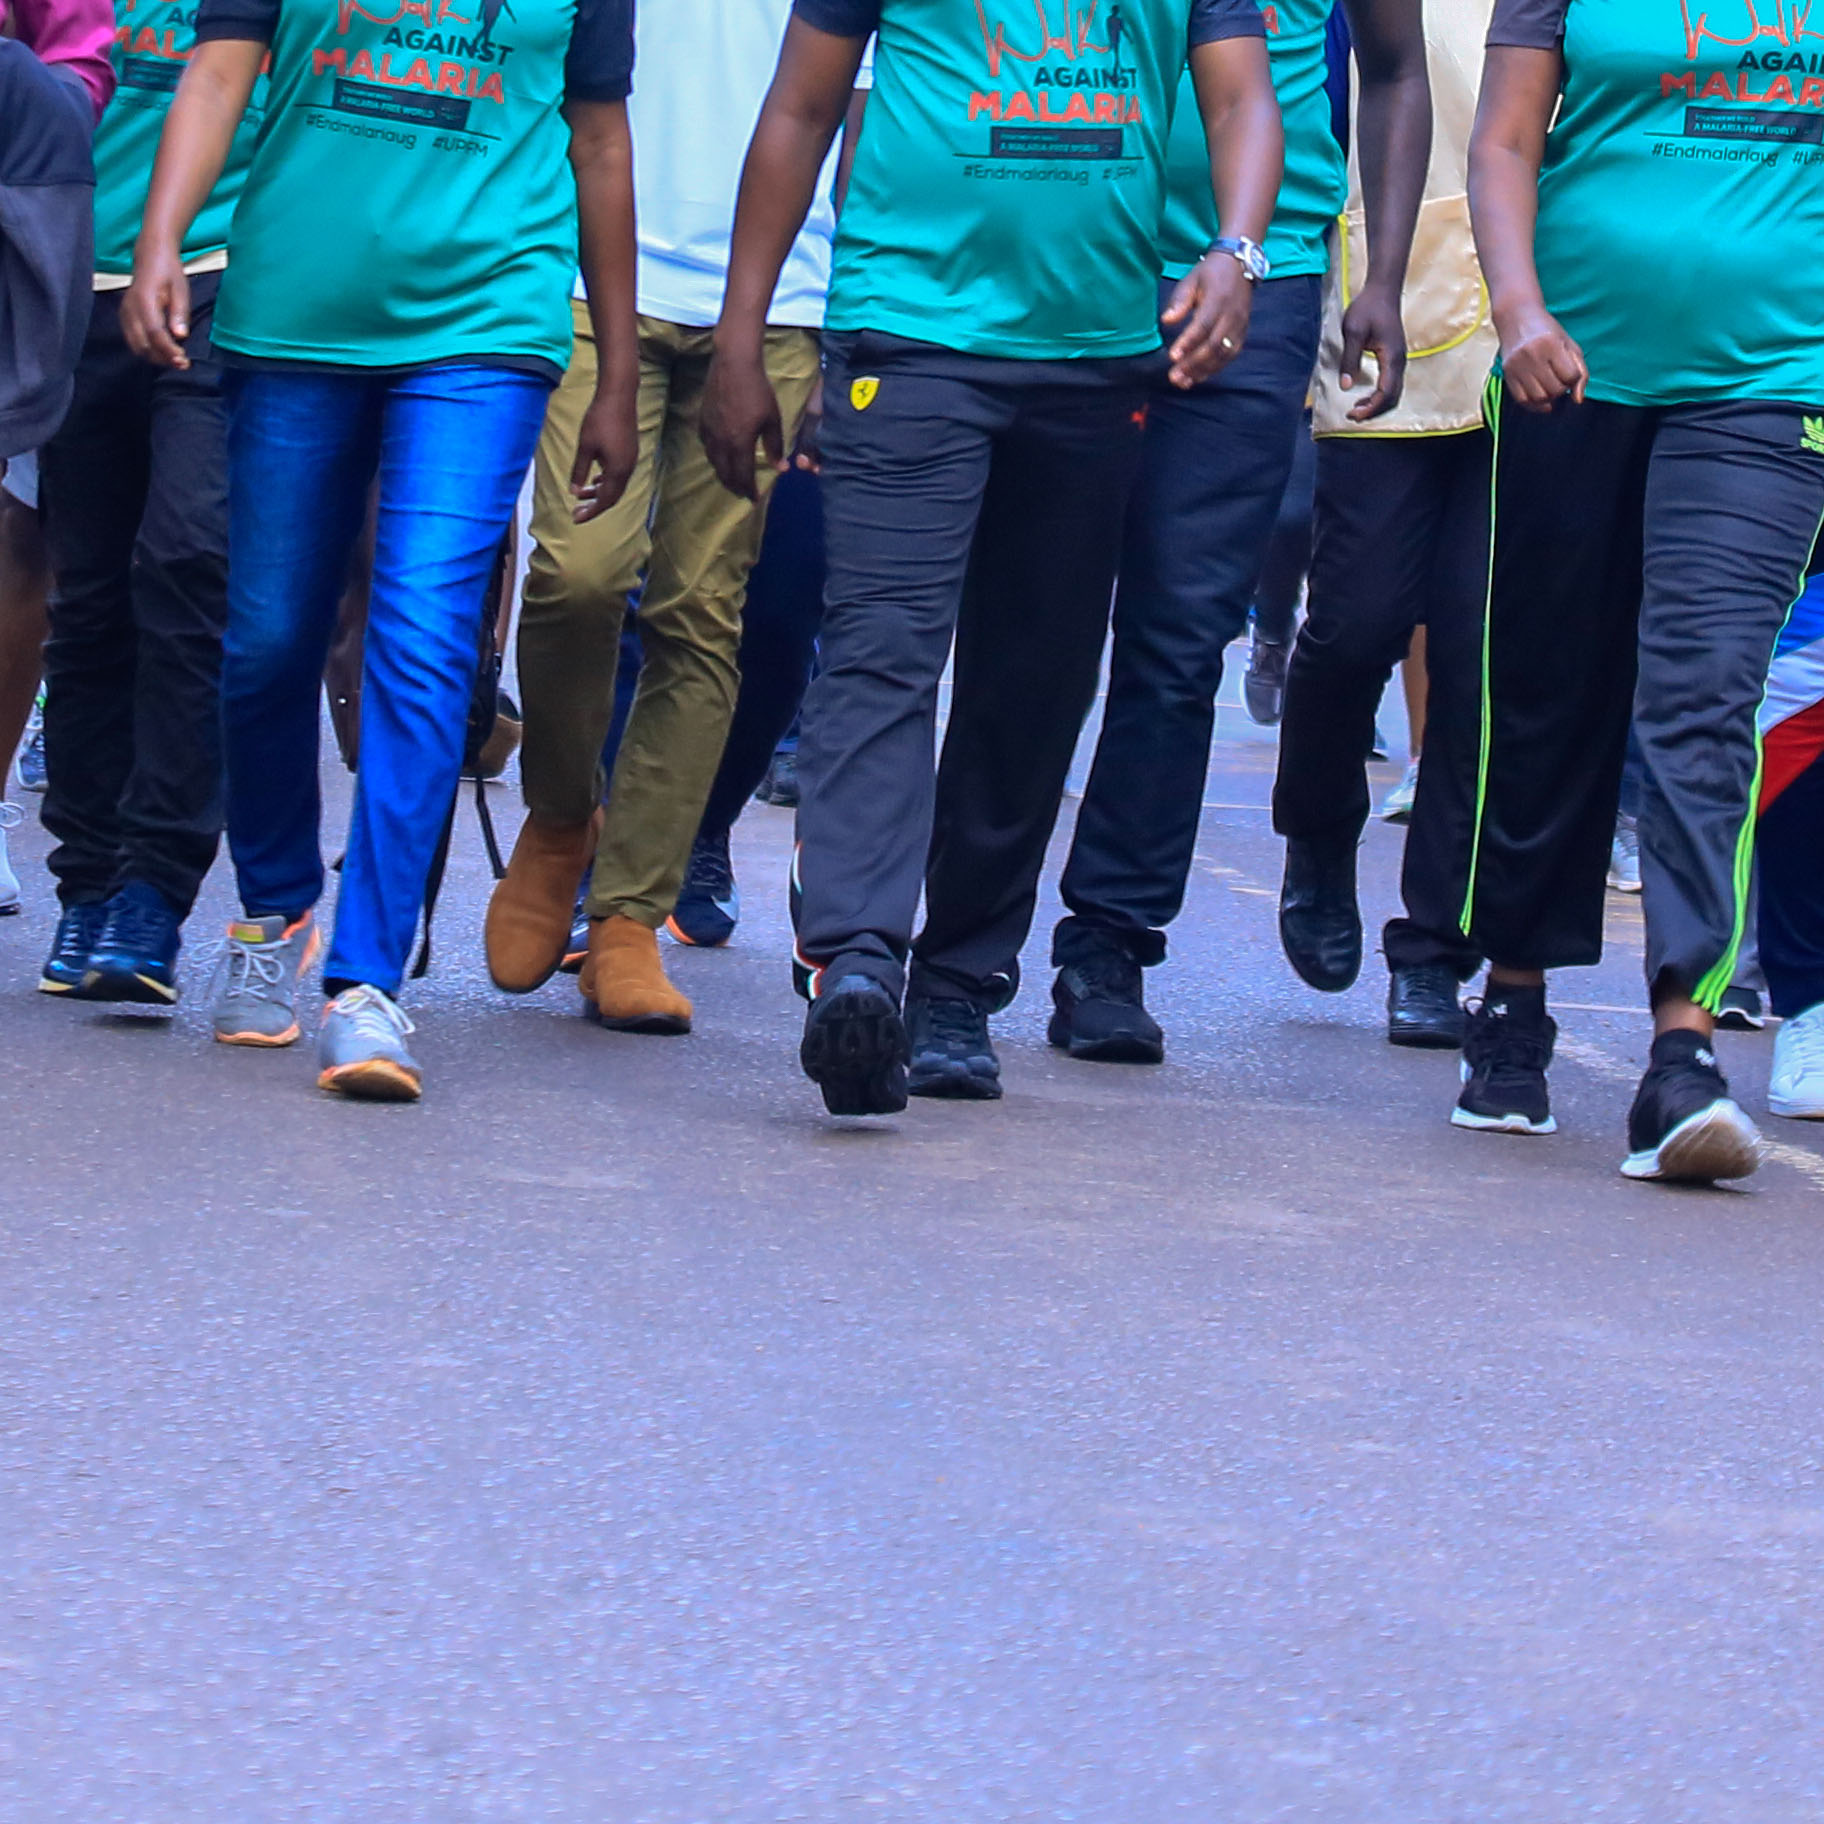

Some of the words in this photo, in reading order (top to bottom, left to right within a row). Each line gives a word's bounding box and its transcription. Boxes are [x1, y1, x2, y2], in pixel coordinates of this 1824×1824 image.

[383, 26, 515, 67] AGAINST
[312, 48, 505, 105] MALARIA
[1033, 66, 1137, 89] AGAINST
[967, 90, 1143, 125] MALARIA
[1651, 142, 1780, 168] #Endmalariaug
